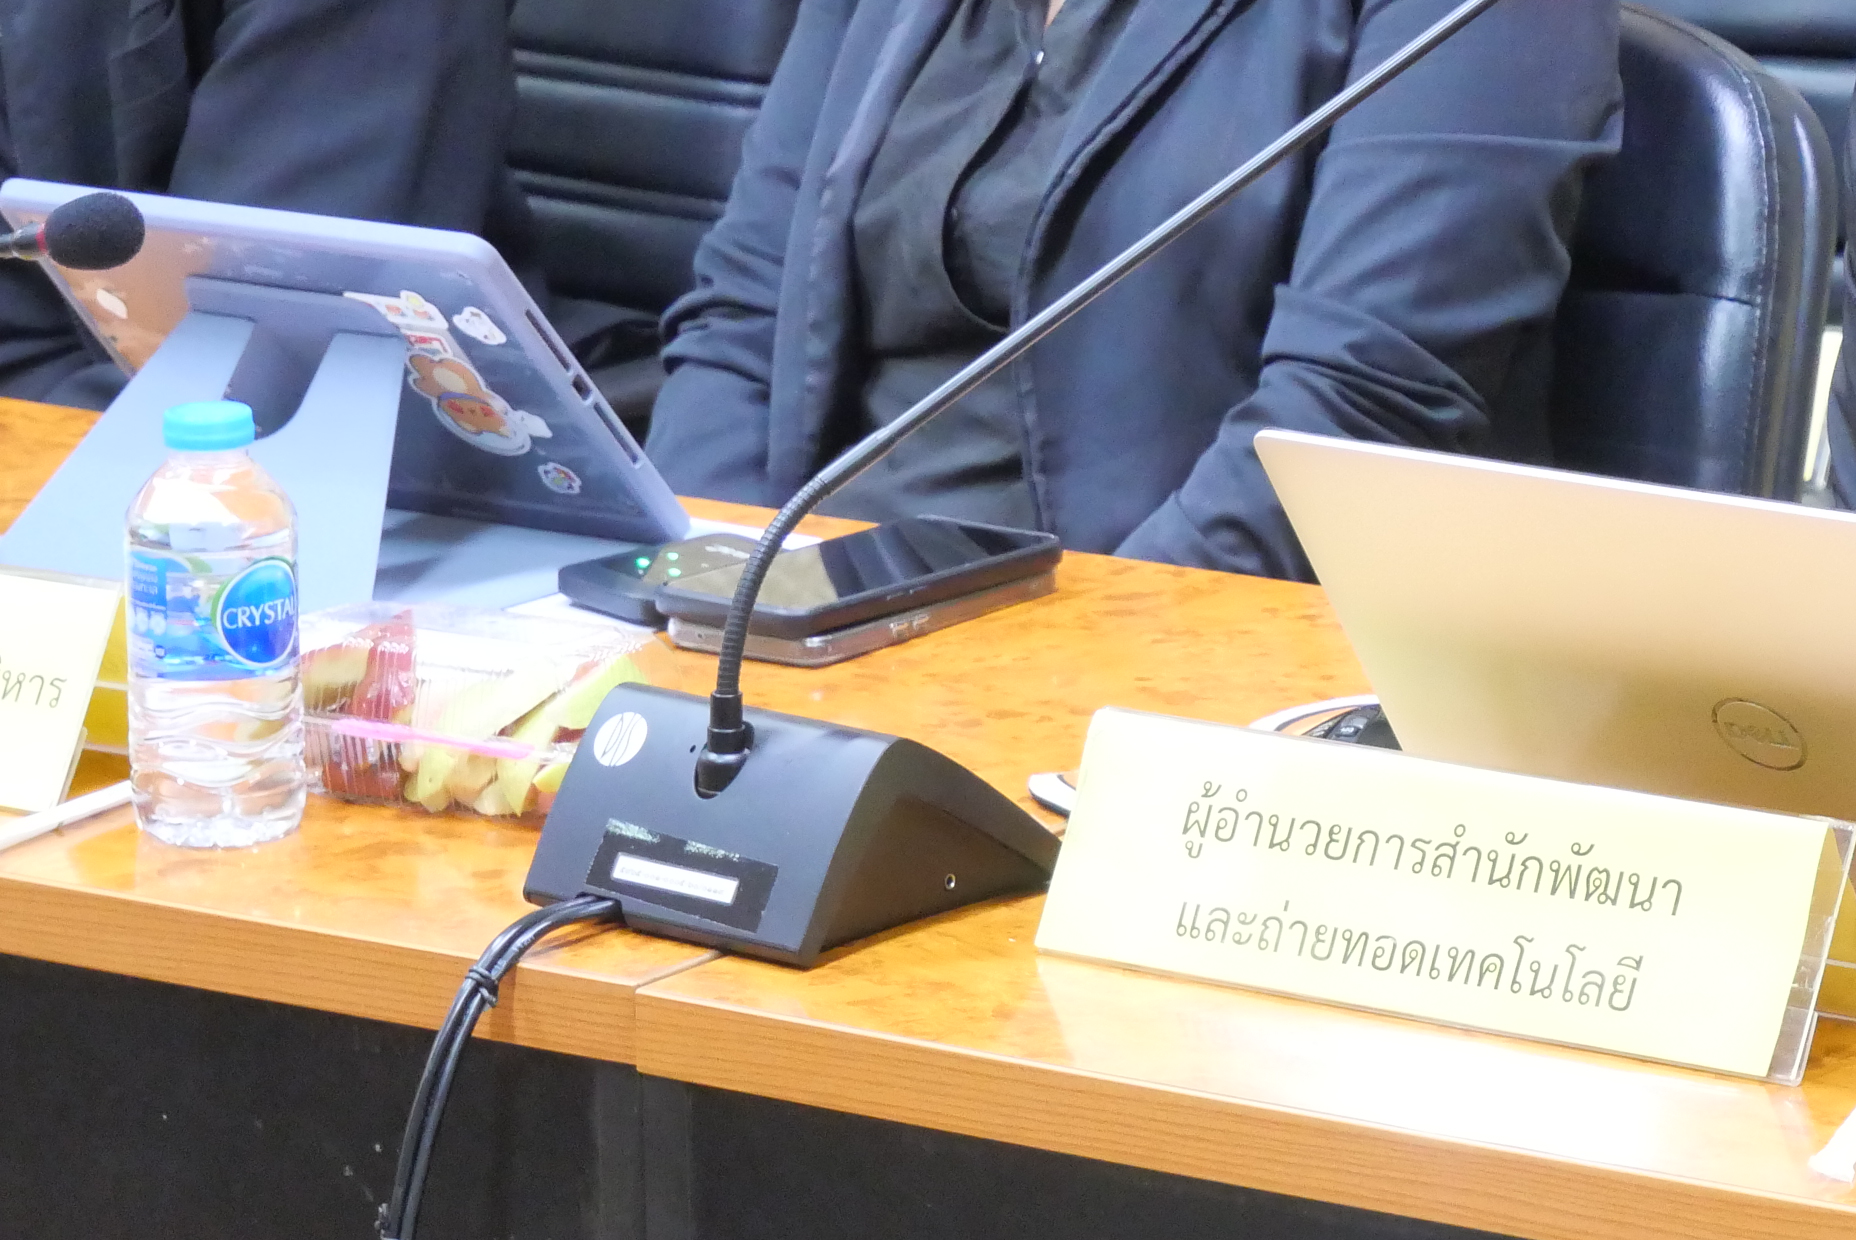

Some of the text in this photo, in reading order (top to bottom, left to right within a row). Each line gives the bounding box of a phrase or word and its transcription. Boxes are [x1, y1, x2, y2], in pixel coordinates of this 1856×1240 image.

[0, 655, 67, 709] หาร
[1181, 780, 1683, 916] ผู้อำนวยการสำนักพัฒนา
[1175, 900, 1644, 1012] และถ่ายทอดเทคโนโลยี
